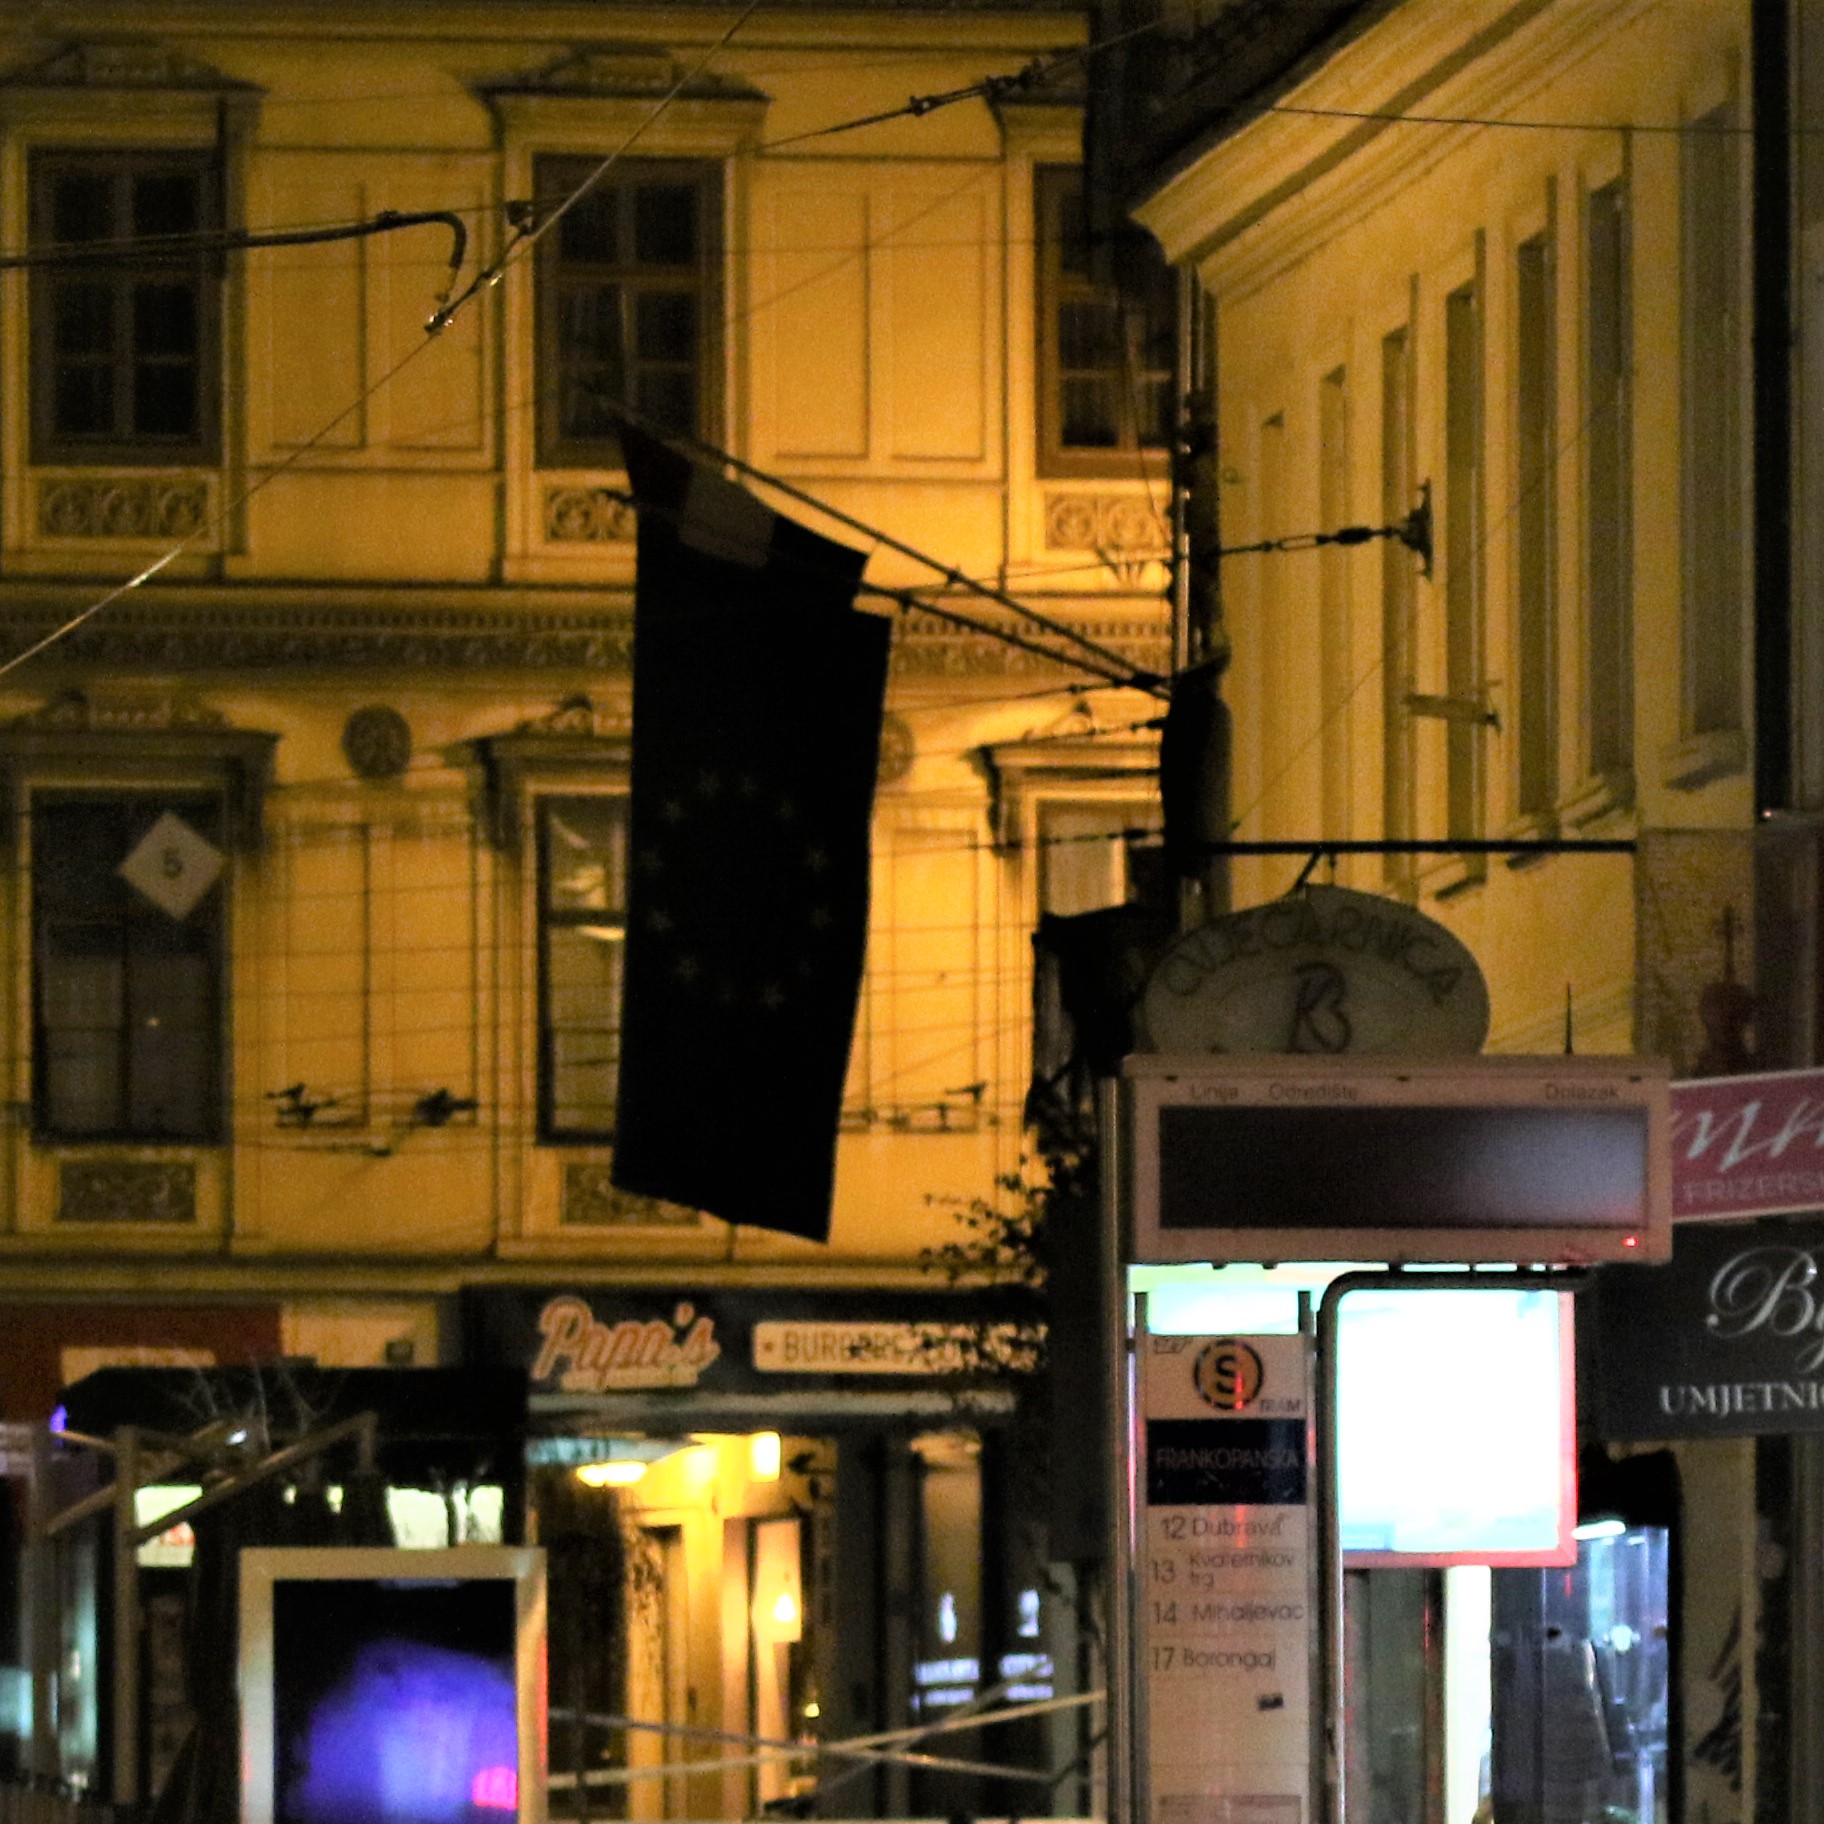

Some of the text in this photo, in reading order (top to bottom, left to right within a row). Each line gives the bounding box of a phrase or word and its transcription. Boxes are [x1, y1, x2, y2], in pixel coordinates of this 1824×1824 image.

[1270, 1082, 1359, 1101] Odredište
[1545, 1082, 1620, 1101] Dolazak
[1155, 1448, 1299, 1470] FRANKOPANSKA
[1163, 1516, 1185, 1539] 12
[1152, 1559, 1175, 1584] 13
[1153, 1647, 1175, 1670] 17
